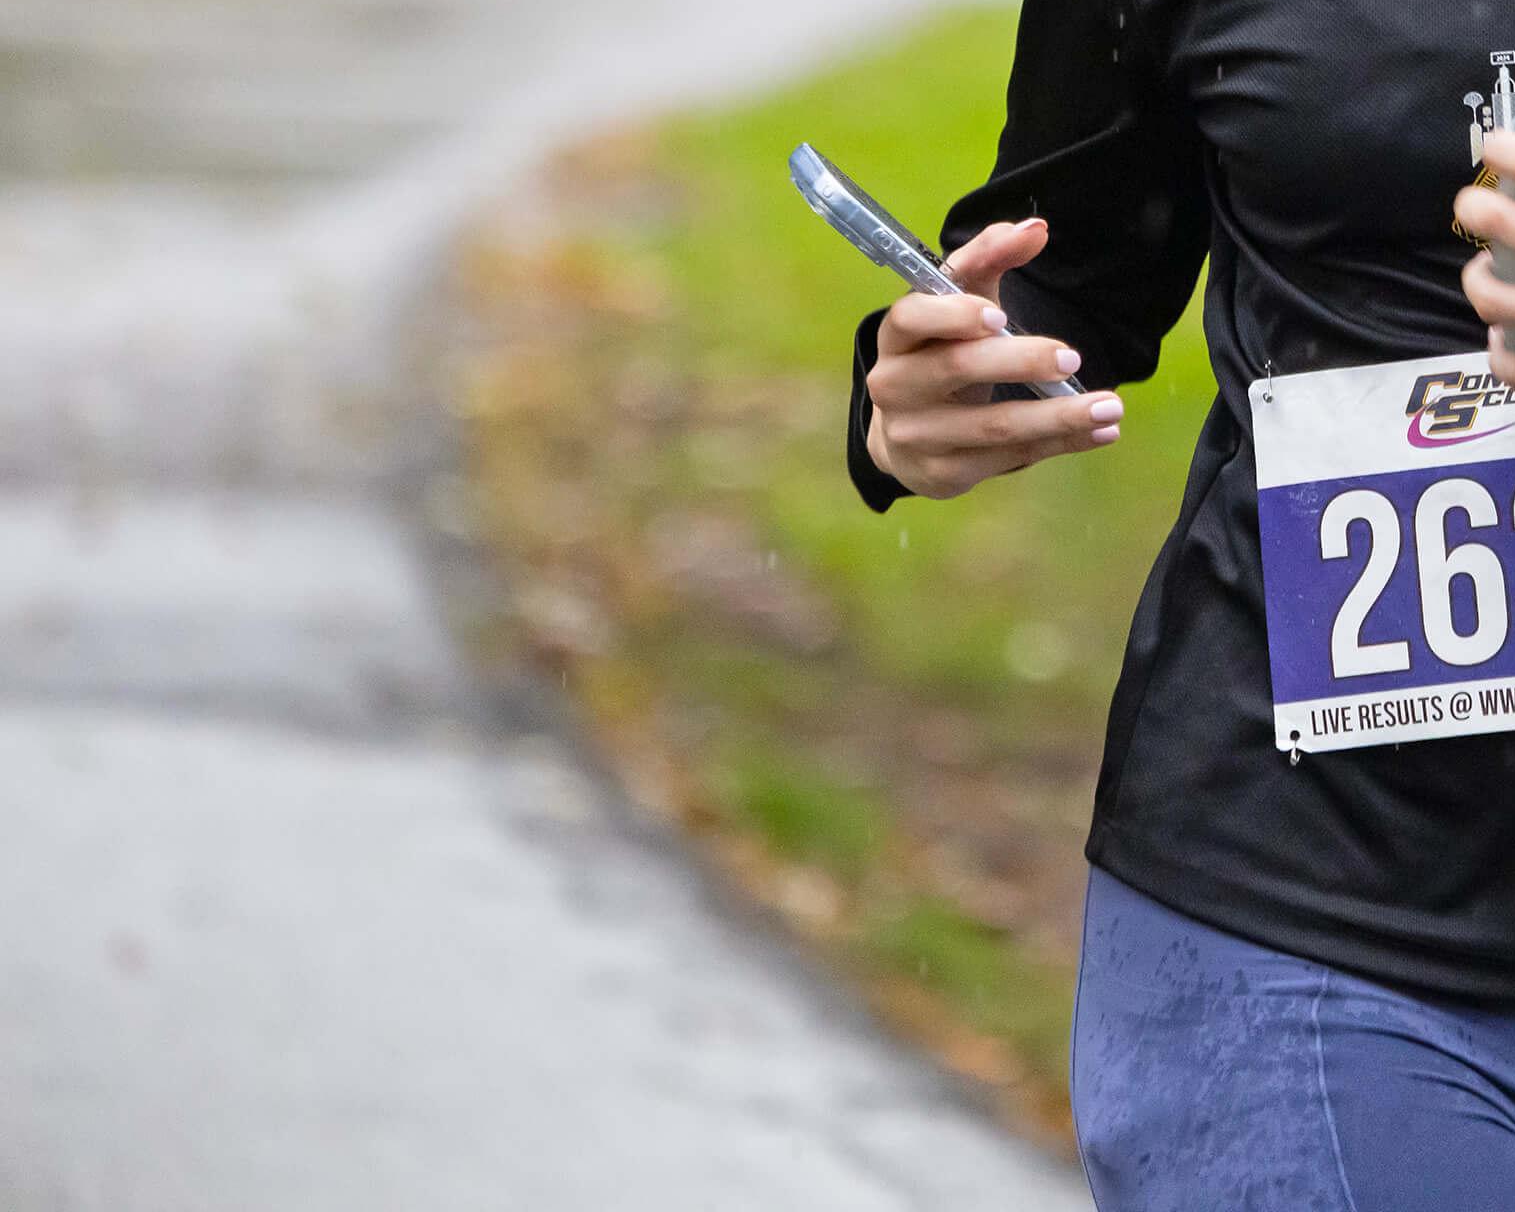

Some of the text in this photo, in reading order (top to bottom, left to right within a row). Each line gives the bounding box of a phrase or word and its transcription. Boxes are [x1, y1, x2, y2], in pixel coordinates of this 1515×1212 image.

[1311, 706, 1353, 736] LIVE
[1358, 696, 1443, 730] RESULTS
[1450, 691, 1472, 720] @
